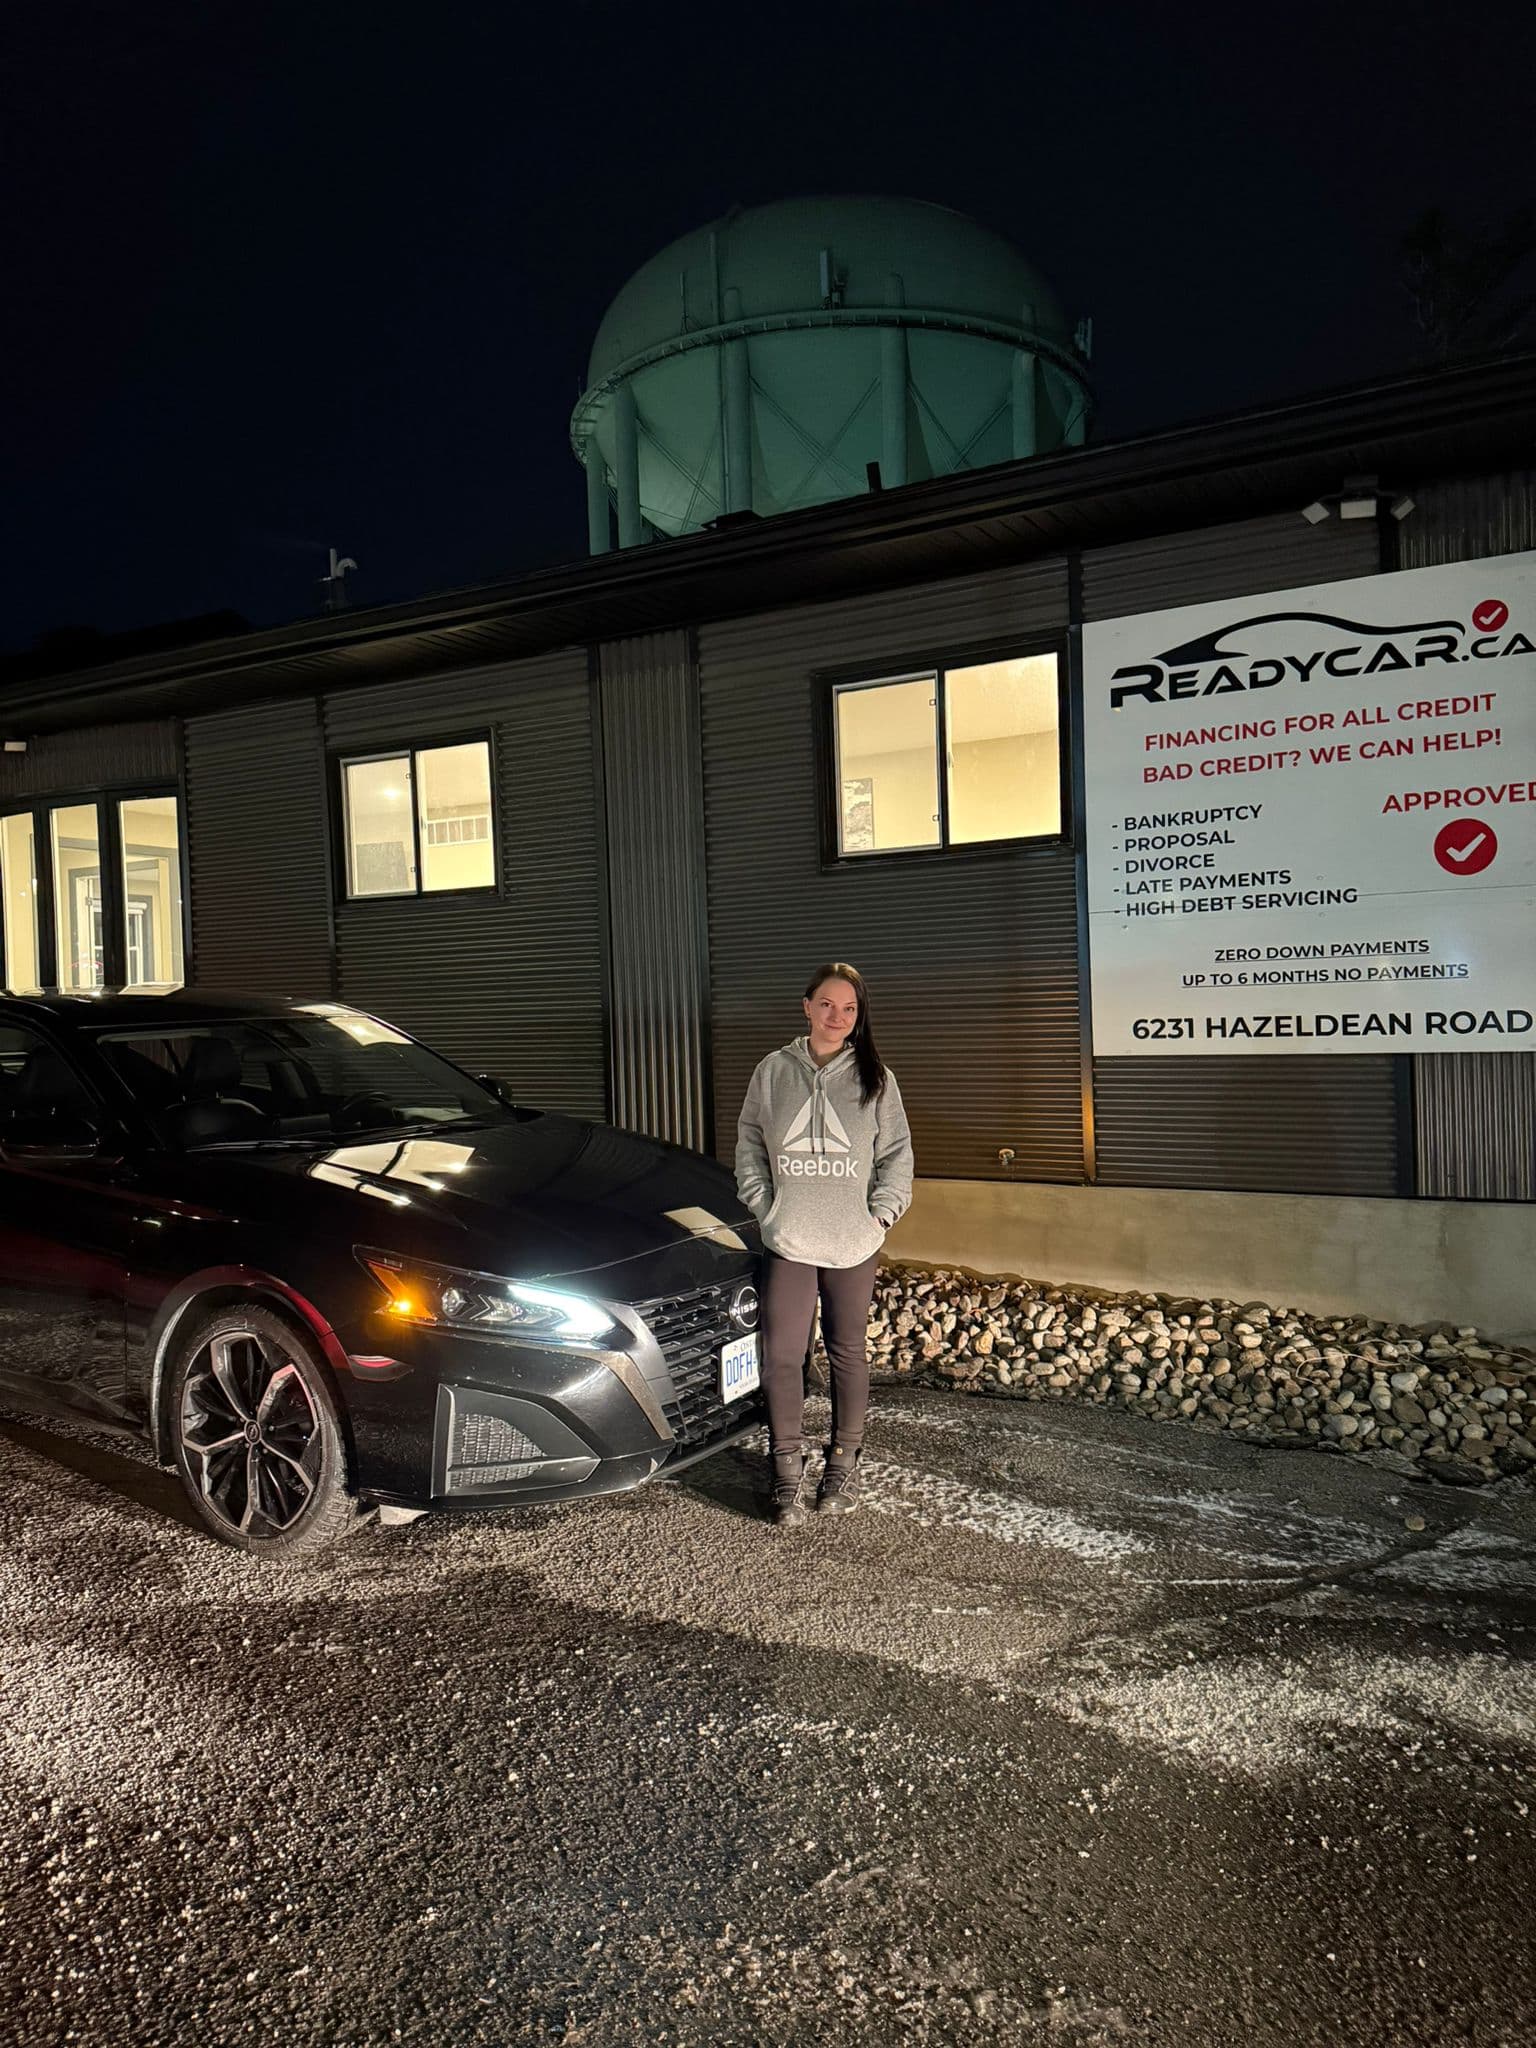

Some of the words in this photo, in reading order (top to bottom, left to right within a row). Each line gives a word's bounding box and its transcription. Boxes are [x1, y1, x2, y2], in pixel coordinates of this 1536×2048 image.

[1144, 717, 1277, 751] FINANCING
[1284, 713, 1335, 734] FOR
[1342, 707, 1391, 727] ALL
[1397, 693, 1496, 720] CREDIT
[1143, 763, 1194, 783] BAD
[1199, 750, 1302, 777] CREDIT?
[1308, 744, 1352, 764] WE
[1358, 738, 1414, 759] CAN
[1422, 728, 1502, 754] HELP!
[1124, 804, 1263, 832] BANKRUPTCY
[1124, 830, 1236, 853] PROPOSAL
[1125, 853, 1216, 874] DIVORCE
[1125, 876, 1174, 896] LATE
[1179, 869, 1292, 892] PAYMENTS
[1126, 898, 1176, 917] HIGH
[1181, 894, 1237, 914] DEBT
[1241, 887, 1359, 911] SERVICING
[1214, 947, 1262, 962] ZERO
[1266, 944, 1325, 959] DOWN
[1329, 940, 1430, 956] PAYMENTS
[1182, 973, 1206, 988] UP
[1209, 971, 1234, 985] TO
[1237, 970, 1249, 984] 6
[1252, 967, 1330, 984] MONTHS
[1334, 966, 1362, 981] NO
[1367, 964, 1469, 980] PAYMENTS
[1133, 1017, 1195, 1039] 6231
[1205, 1012, 1413, 1038] HAZELDEAN
[1424, 1010, 1533, 1035] ROAD
[776, 1154, 858, 1178] Reebok
